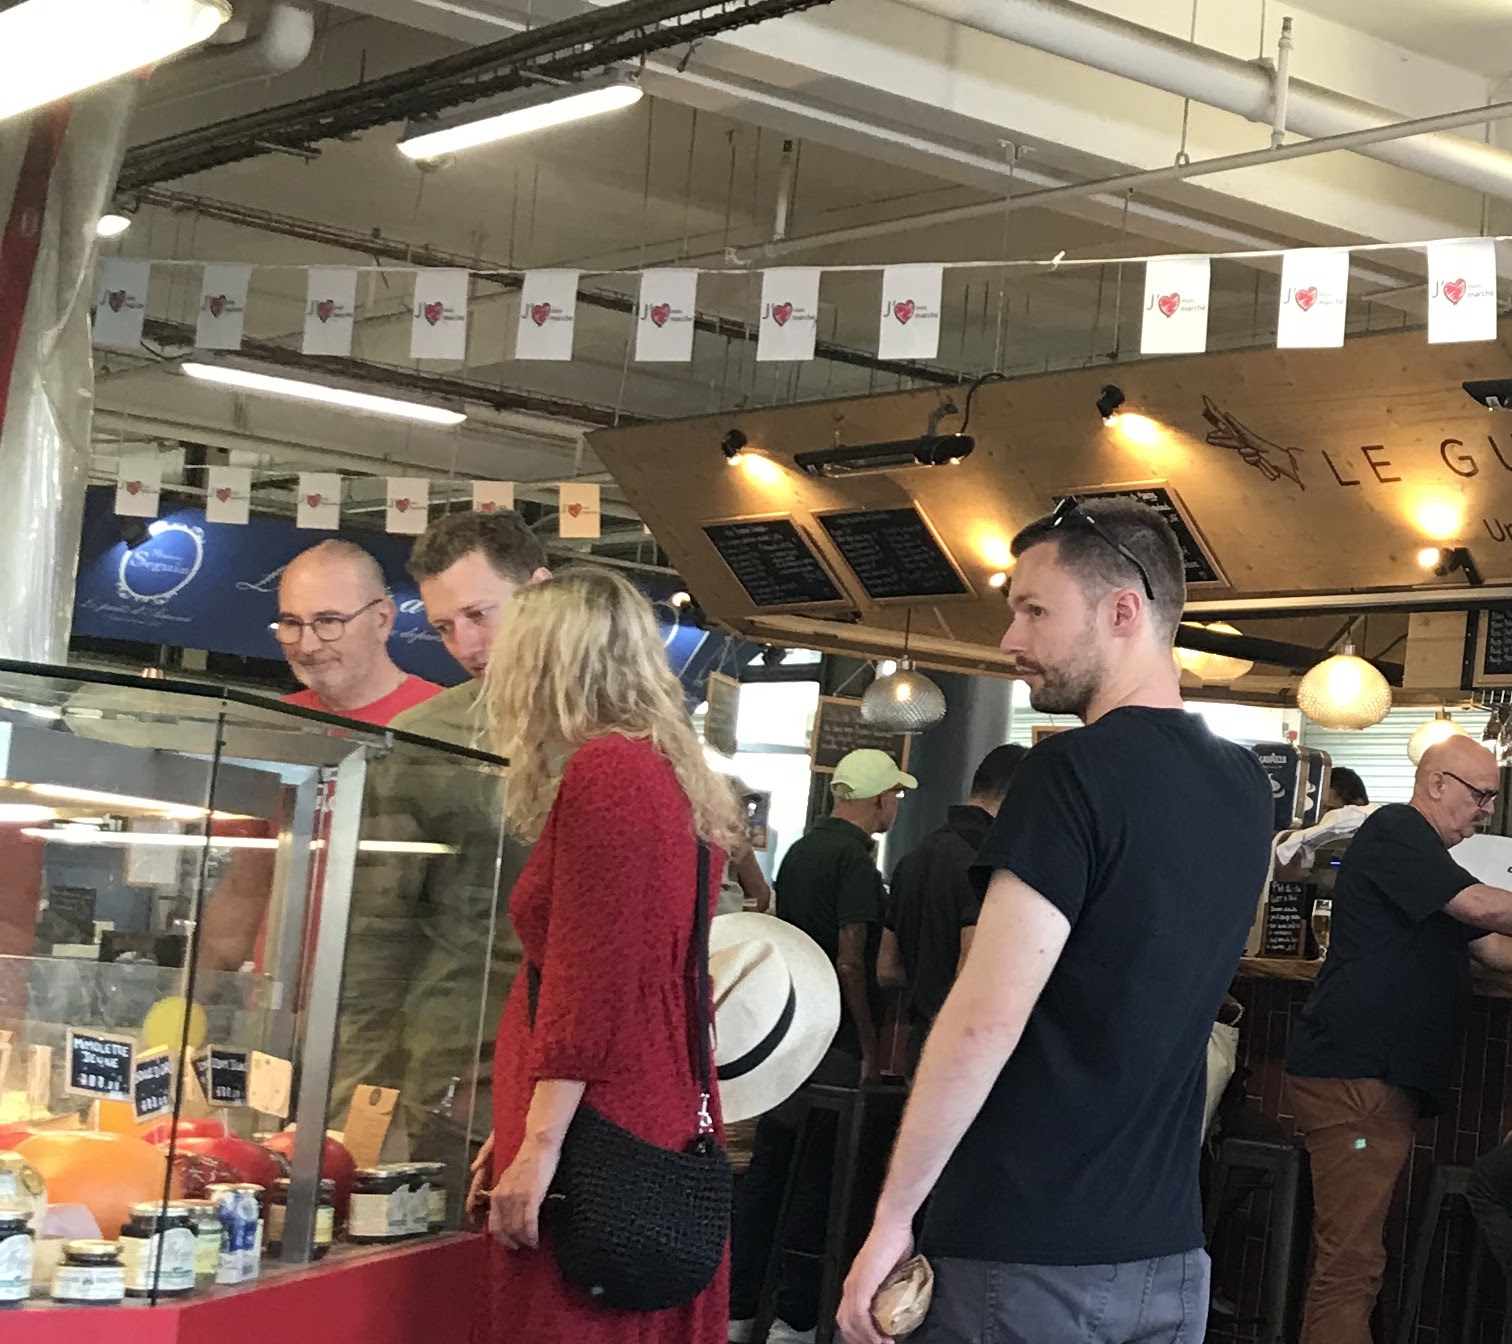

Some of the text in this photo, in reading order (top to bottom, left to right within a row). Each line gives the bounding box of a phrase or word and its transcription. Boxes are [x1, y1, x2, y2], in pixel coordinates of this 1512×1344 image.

[1432, 280, 1445, 298] J'
[1147, 294, 1160, 311] J'
[1322, 444, 1402, 487] LE
